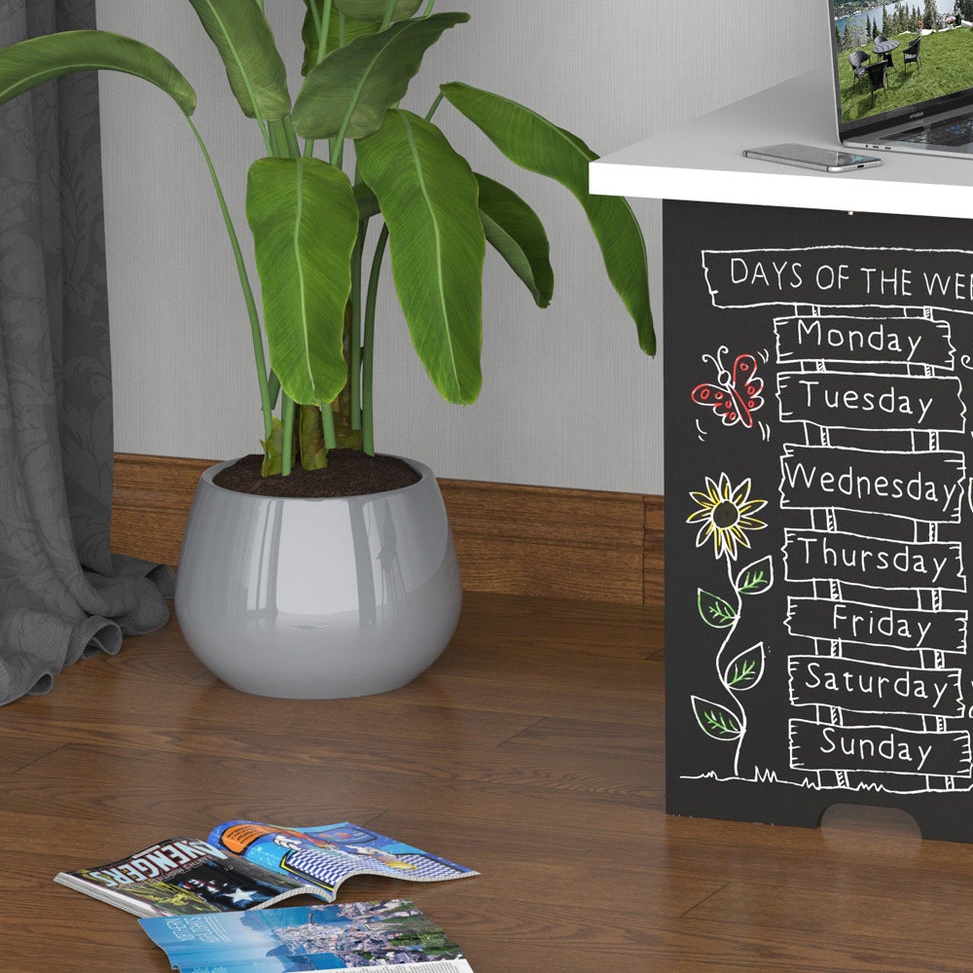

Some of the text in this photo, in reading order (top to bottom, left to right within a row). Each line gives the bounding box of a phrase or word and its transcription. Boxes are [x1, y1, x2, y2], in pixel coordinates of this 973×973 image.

[730, 257, 803, 290] DAYS
[815, 264, 849, 290] OF
[860, 267, 912, 296] THE
[798, 319, 922, 360] Monday
[799, 380, 933, 423] Tuesday
[784, 462, 957, 513] Wednesday
[798, 537, 948, 582] Thursday
[832, 604, 932, 647] Friday
[805, 663, 949, 708] Saturday
[820, 727, 932, 770] Sunday
